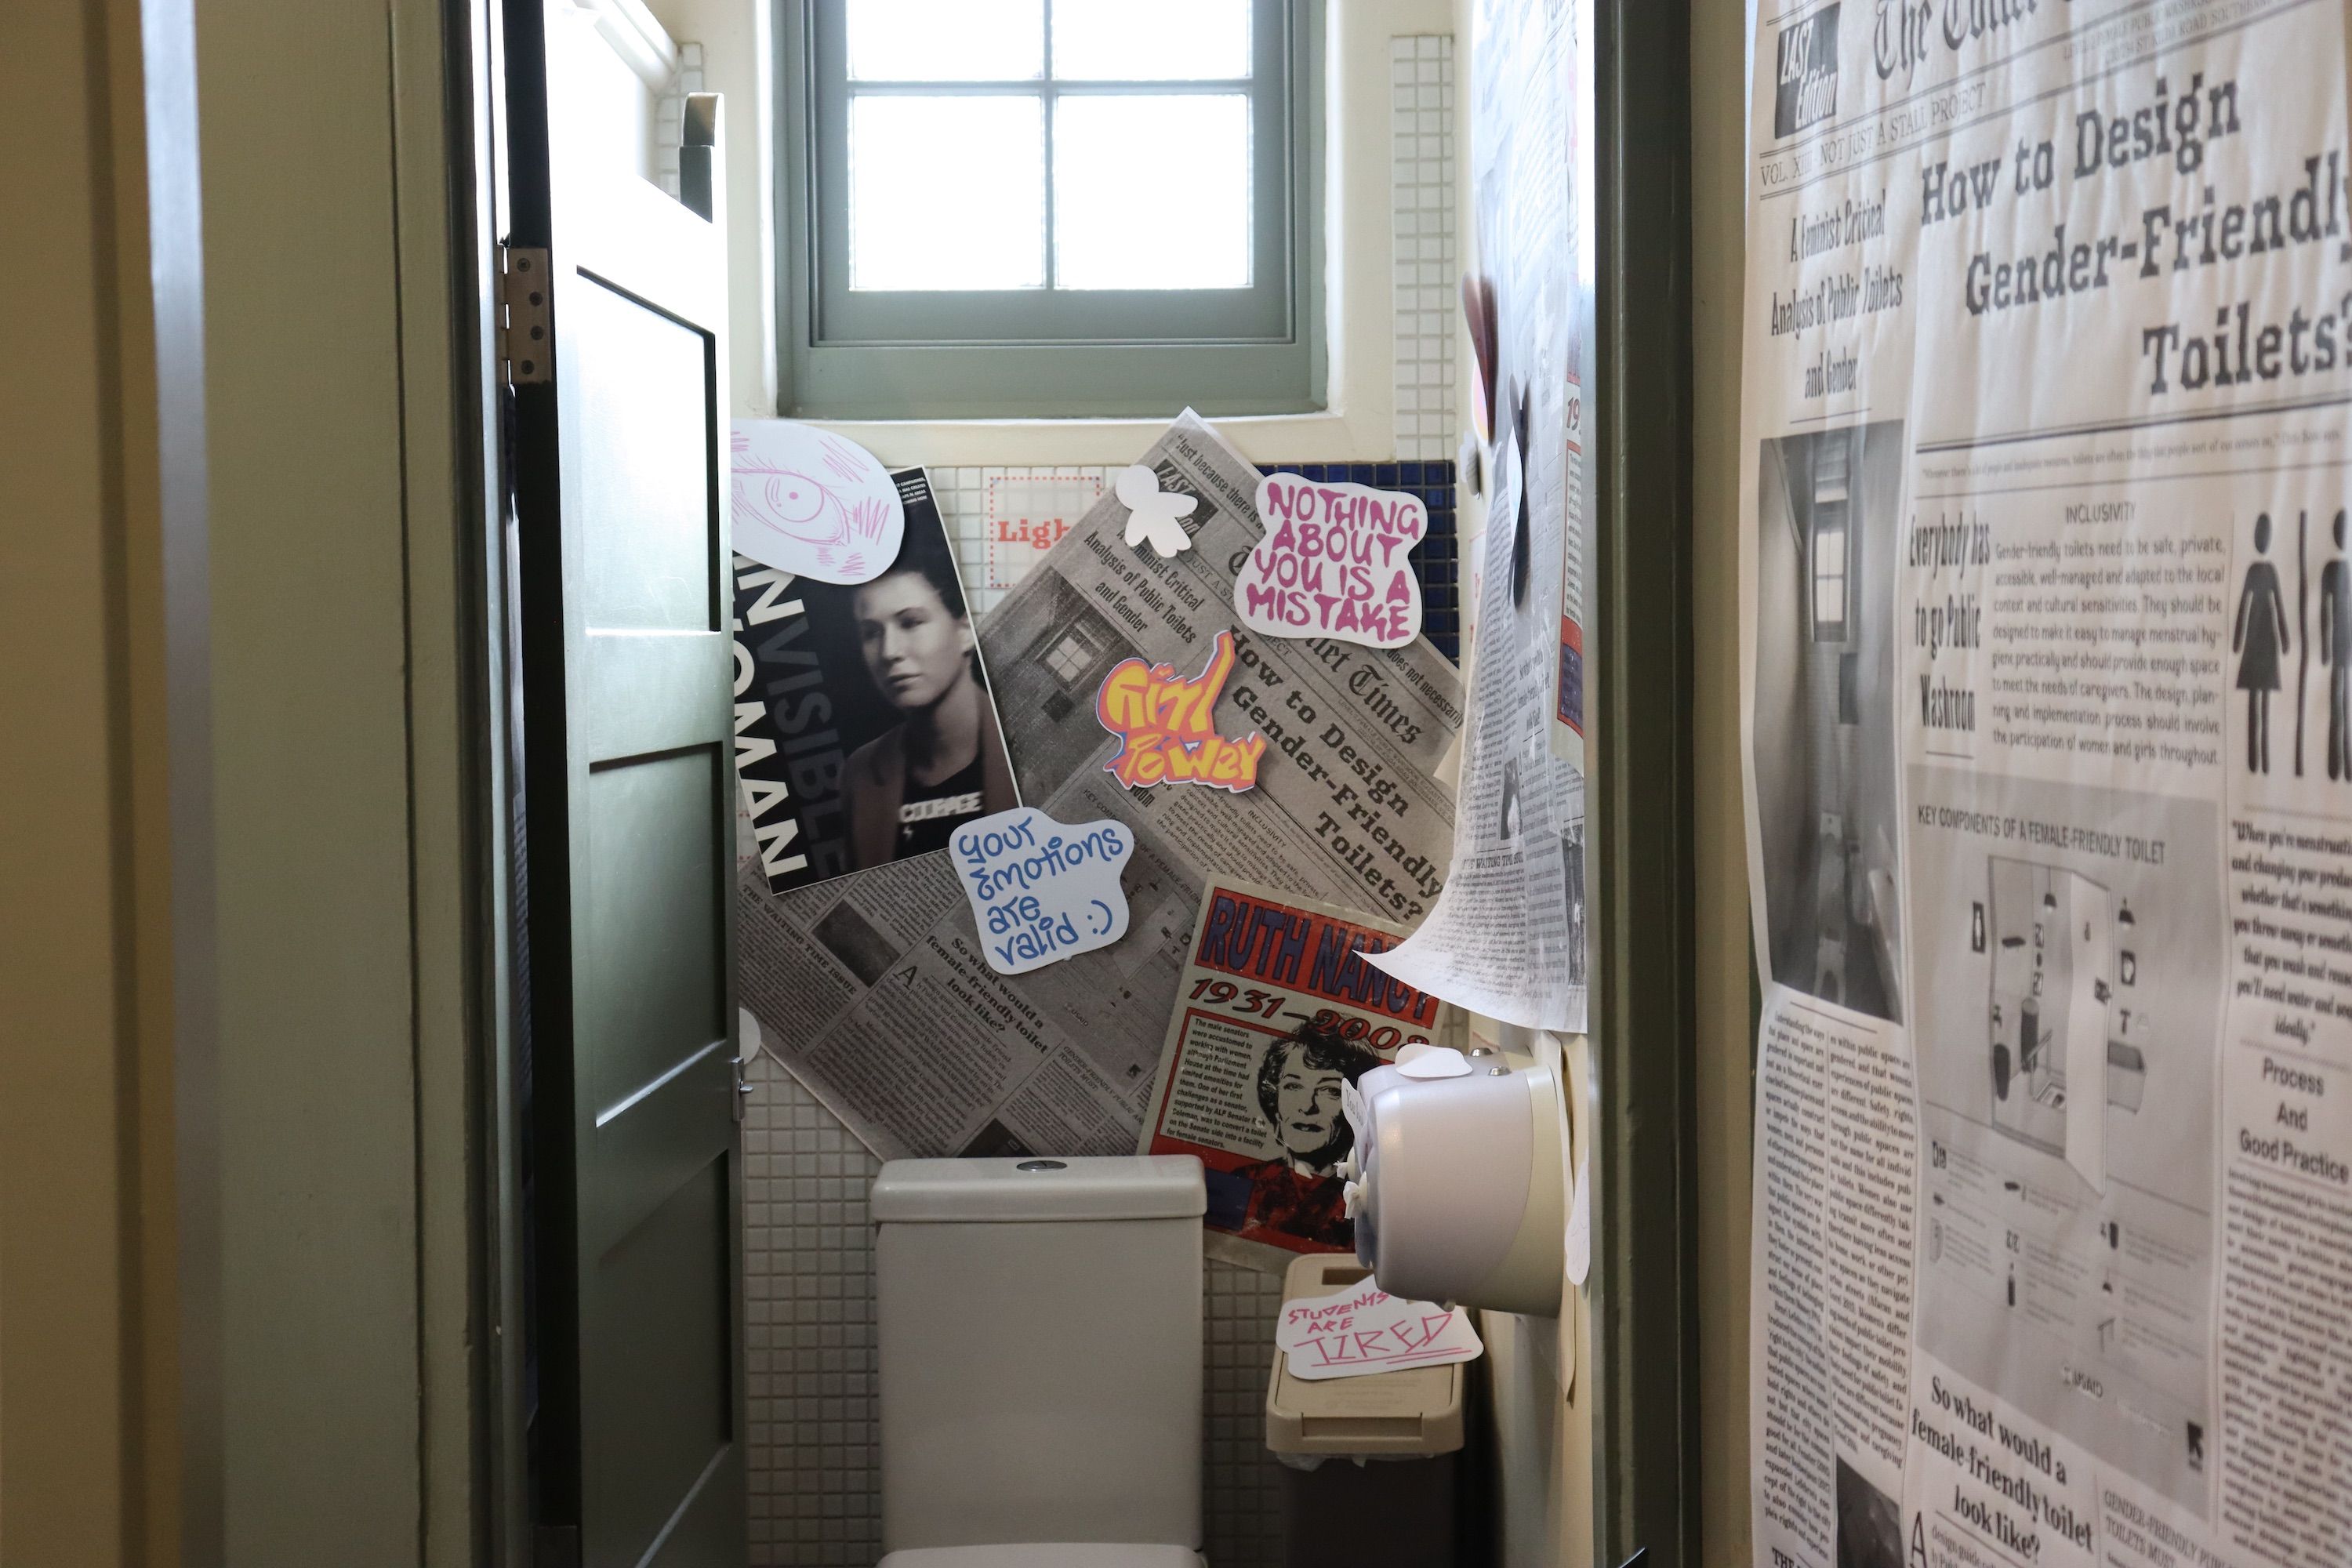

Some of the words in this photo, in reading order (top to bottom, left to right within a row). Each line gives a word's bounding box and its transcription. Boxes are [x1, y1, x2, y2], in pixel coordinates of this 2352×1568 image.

[1780, 18, 1814, 85] LAST
[1795, 65, 1837, 129] Edition
[1760, 164, 1788, 186] VOL.
[1819, 139, 1846, 166] NOT
[1848, 126, 1874, 157] JUST
[1878, 122, 1887, 144] A
[1889, 107, 1927, 141] STALL
[1931, 82, 1986, 125] PROJECT
[1922, 159, 2001, 226] How
[2015, 136, 2054, 195] to
[2074, 71, 2241, 180] Design
[1791, 218, 1798, 263] A
[1802, 209, 1842, 260] Feminist
[1844, 188, 1886, 246] Critical
[1771, 289, 1814, 341] Analysis
[1816, 282, 1826, 325] of
[1828, 273, 1860, 323] Public
[1862, 265, 1903, 315] Toilets
[1804, 352, 1824, 399] and
[1828, 347, 1858, 395] Gender
[1192, 453, 1232, 492] because
[1225, 485, 1254, 514] there
[1267, 482, 1419, 540] NOTHING
[2066, 502, 2136, 524] INCLUSIVITY
[1272, 520, 1403, 568] ABOUT
[1910, 511, 1969, 580] Everybody
[1971, 511, 1990, 565] has
[1080, 529, 1131, 578] Analysis
[1121, 567, 1142, 587] of
[1132, 578, 1169, 613] Public
[1159, 604, 1201, 644] Toilets
[1129, 538, 1171, 579] eminist
[1163, 570, 1206, 612] Critical
[1255, 549, 1323, 592] YOU
[1340, 564, 1374, 601] IS
[1386, 570, 1410, 604] A
[2197, 565, 2224, 583] local
[1094, 578, 1120, 603] and
[1111, 594, 1152, 633] Gender
[1247, 583, 1410, 641] MISTAKE
[1915, 598, 1927, 647] to
[1931, 607, 1944, 660] go
[1947, 594, 1981, 648] Public
[2143, 594, 2168, 618] They
[2171, 597, 2204, 613] should
[2208, 597, 2223, 613] be
[1385, 648, 1410, 672] does
[1404, 666, 1424, 686] not
[1348, 664, 1424, 744] Times
[1921, 673, 1976, 731] Washroom
[1283, 688, 1321, 725] to
[1312, 721, 1417, 822] Design
[1233, 686, 1443, 898] Gender-Friendly
[1247, 809, 1287, 848] INCLUSIVITY
[1918, 805, 1936, 825] KEY
[1940, 807, 2001, 837] COMPONENTS
[2003, 818, 2016, 839] OF
[2020, 819, 2027, 841] A
[2029, 821, 2122, 859] FEMALE-FRIENDLY
[2125, 836, 2166, 864] TOILET
[1225, 850, 1244, 868] should
[1269, 869, 1285, 885] They
[1316, 811, 1423, 920] Toilets?
[741, 884, 763, 905] THE
[760, 902, 804, 945] WAITING
[803, 943, 829, 968] TIME
[827, 967, 857, 995] ISSUE
[987, 896, 1040, 935] are
[995, 912, 1079, 966] valid
[1201, 896, 1312, 985] RUTH
[893, 965, 918, 989] A
[923, 934, 1019, 1025] female-friendly
[1014, 1020, 1049, 1054] toilet
[949, 936, 971, 957] So
[965, 952, 1001, 986] what
[996, 982, 1037, 1022] would
[1033, 1018, 1044, 1029] a
[946, 978, 977, 1007] look
[972, 1002, 1007, 1036] like?
[1071, 1009, 1089, 1027] USAID
[1194, 1018, 1207, 1027] The
[1207, 1022, 1222, 1031] male
[1222, 1025, 1249, 1038] senators
[1184, 1058, 1203, 1069] House
[1211, 1065, 1221, 1073] the
[1222, 1068, 1236, 1076] time
[1207, 1033, 1244, 1047] accustomed
[1062, 1045, 1116, 1097] GENDER-FRIENDLY
[1112, 1093, 1134, 1114] PUBLIC
[1176, 1088, 1209, 1102] challenges
[1223, 1100, 1248, 1112] senator,
[1179, 1078, 1196, 1088] them.
[1197, 1083, 1210, 1091] One
[1218, 1087, 1229, 1096] her
[1229, 1091, 1242, 1099] first
[2263, 1056, 2325, 1098] Process
[2277, 1101, 2308, 1133] And
[2241, 1127, 2278, 1162] Good
[2284, 1139, 2350, 1185] Practice
[1288, 1291, 1391, 1325] STUDENTS
[1308, 1317, 1355, 1334] ARE
[1294, 1313, 1453, 1364] TIRED
[1931, 1374, 1951, 1411] So
[1951, 1394, 1994, 1439] what
[1999, 1425, 2052, 1476] would
[2056, 1461, 2067, 1486] a
[1911, 1408, 2041, 1524] female-friendly
[2043, 1494, 2093, 1555] toilet
[1910, 1511, 1928, 1568] A
[1953, 1485, 1992, 1534] look
[1995, 1512, 2040, 1564] like?
[2104, 1490, 2198, 1560] GENDER-FRIENDLY
[2106, 1516, 2147, 1556] TOILETS
